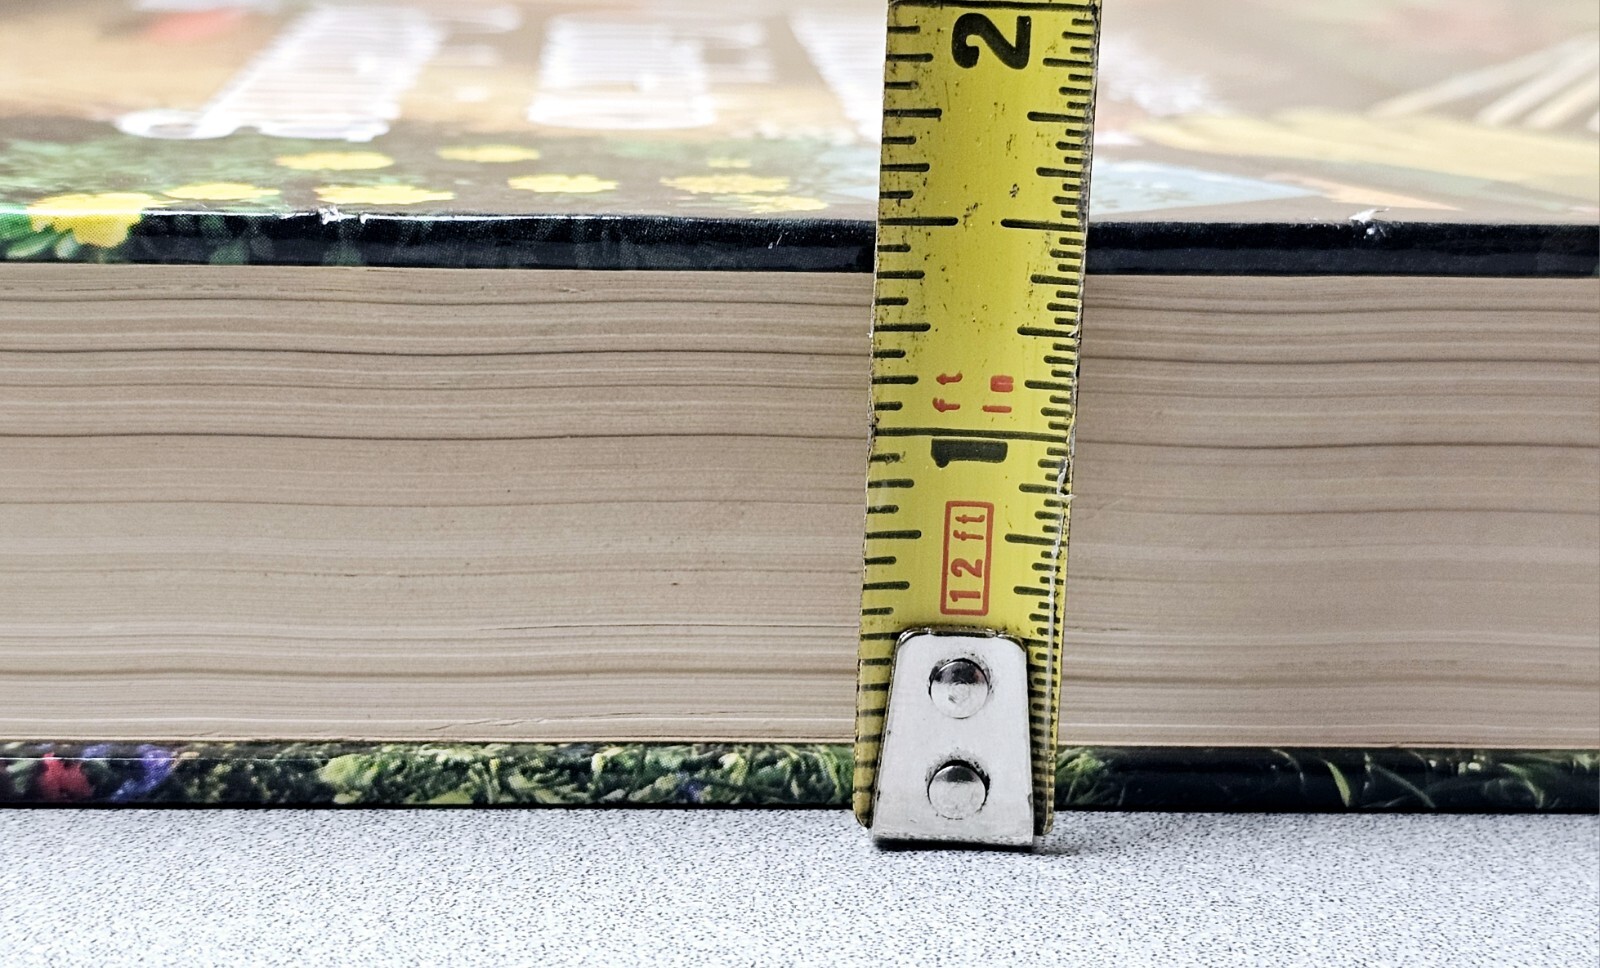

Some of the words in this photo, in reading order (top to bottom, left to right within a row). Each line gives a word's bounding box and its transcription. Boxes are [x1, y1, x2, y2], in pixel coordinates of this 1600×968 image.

[952, 13, 1031, 69] 2
[932, 371, 963, 412] ft
[931, 439, 1008, 468] 1
[953, 514, 985, 541] ft
[949, 558, 983, 602] 12
